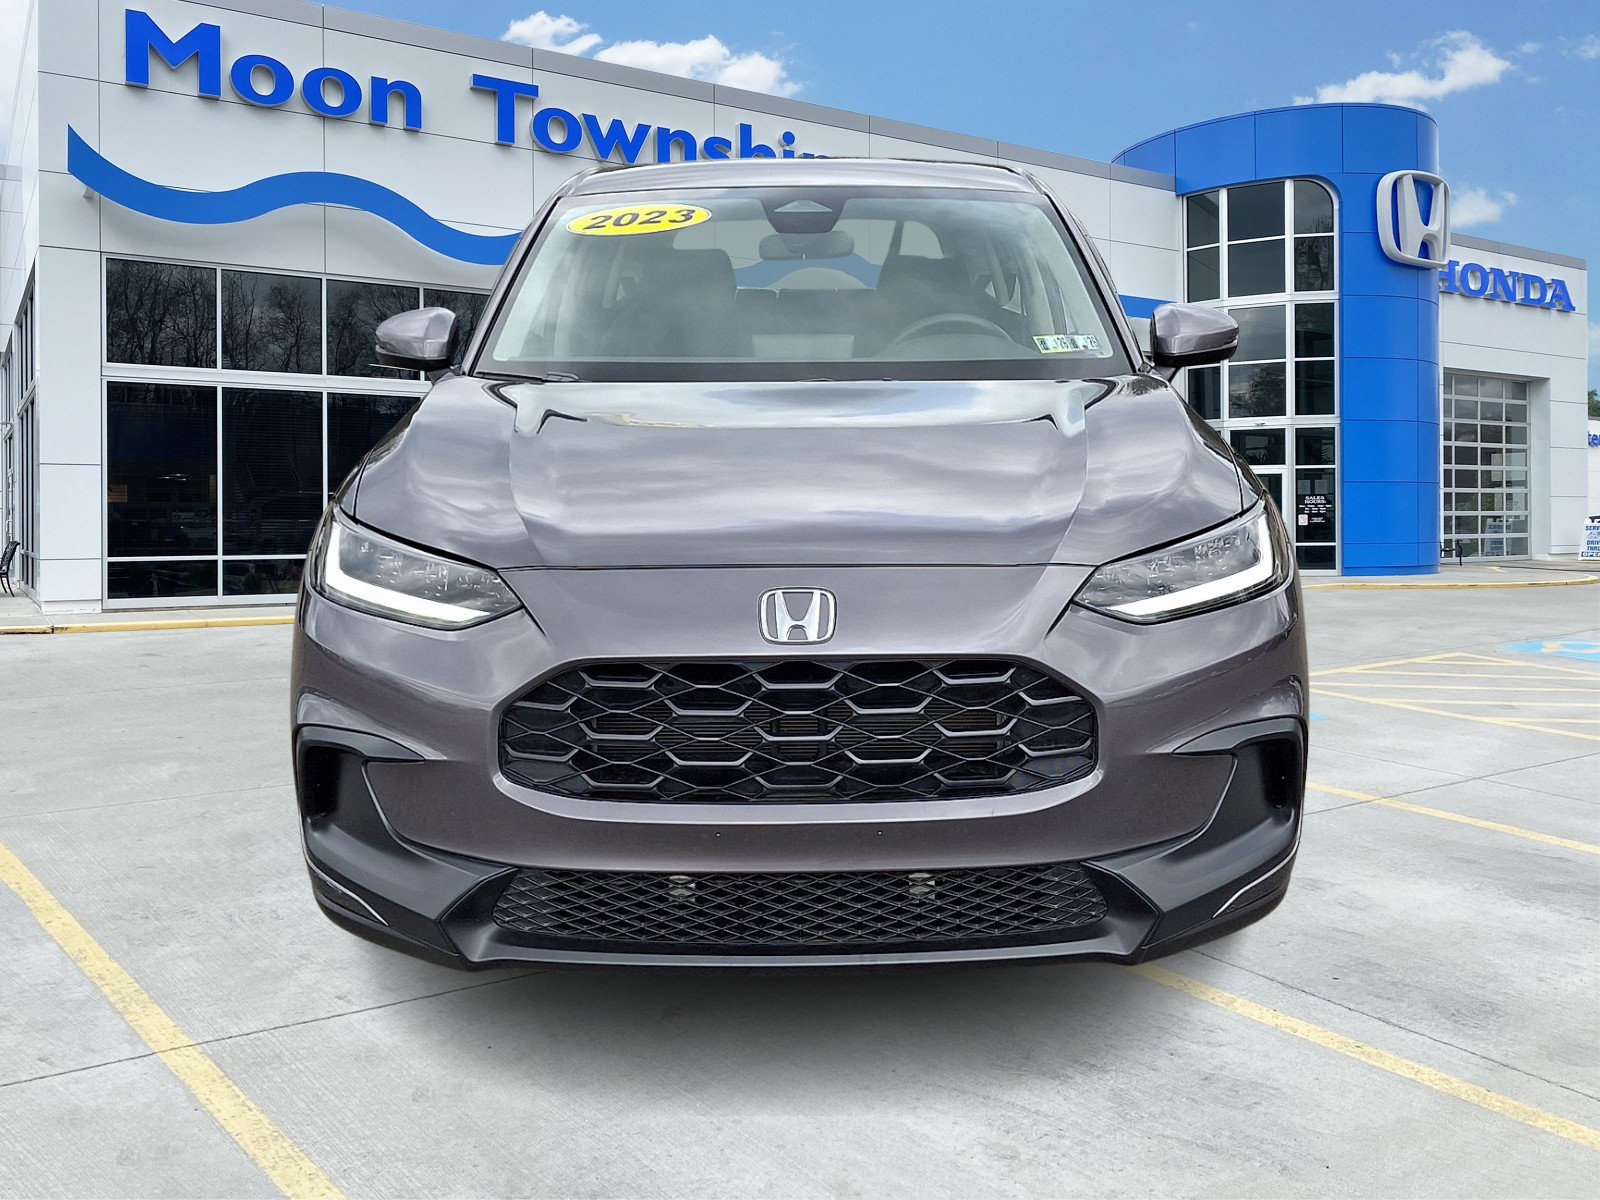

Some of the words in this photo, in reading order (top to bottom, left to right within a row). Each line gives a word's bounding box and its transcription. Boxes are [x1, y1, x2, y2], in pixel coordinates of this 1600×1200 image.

[125, 9, 422, 131] Moon
[470, 74, 832, 164] Townshi
[583, 209, 696, 231] 2023
